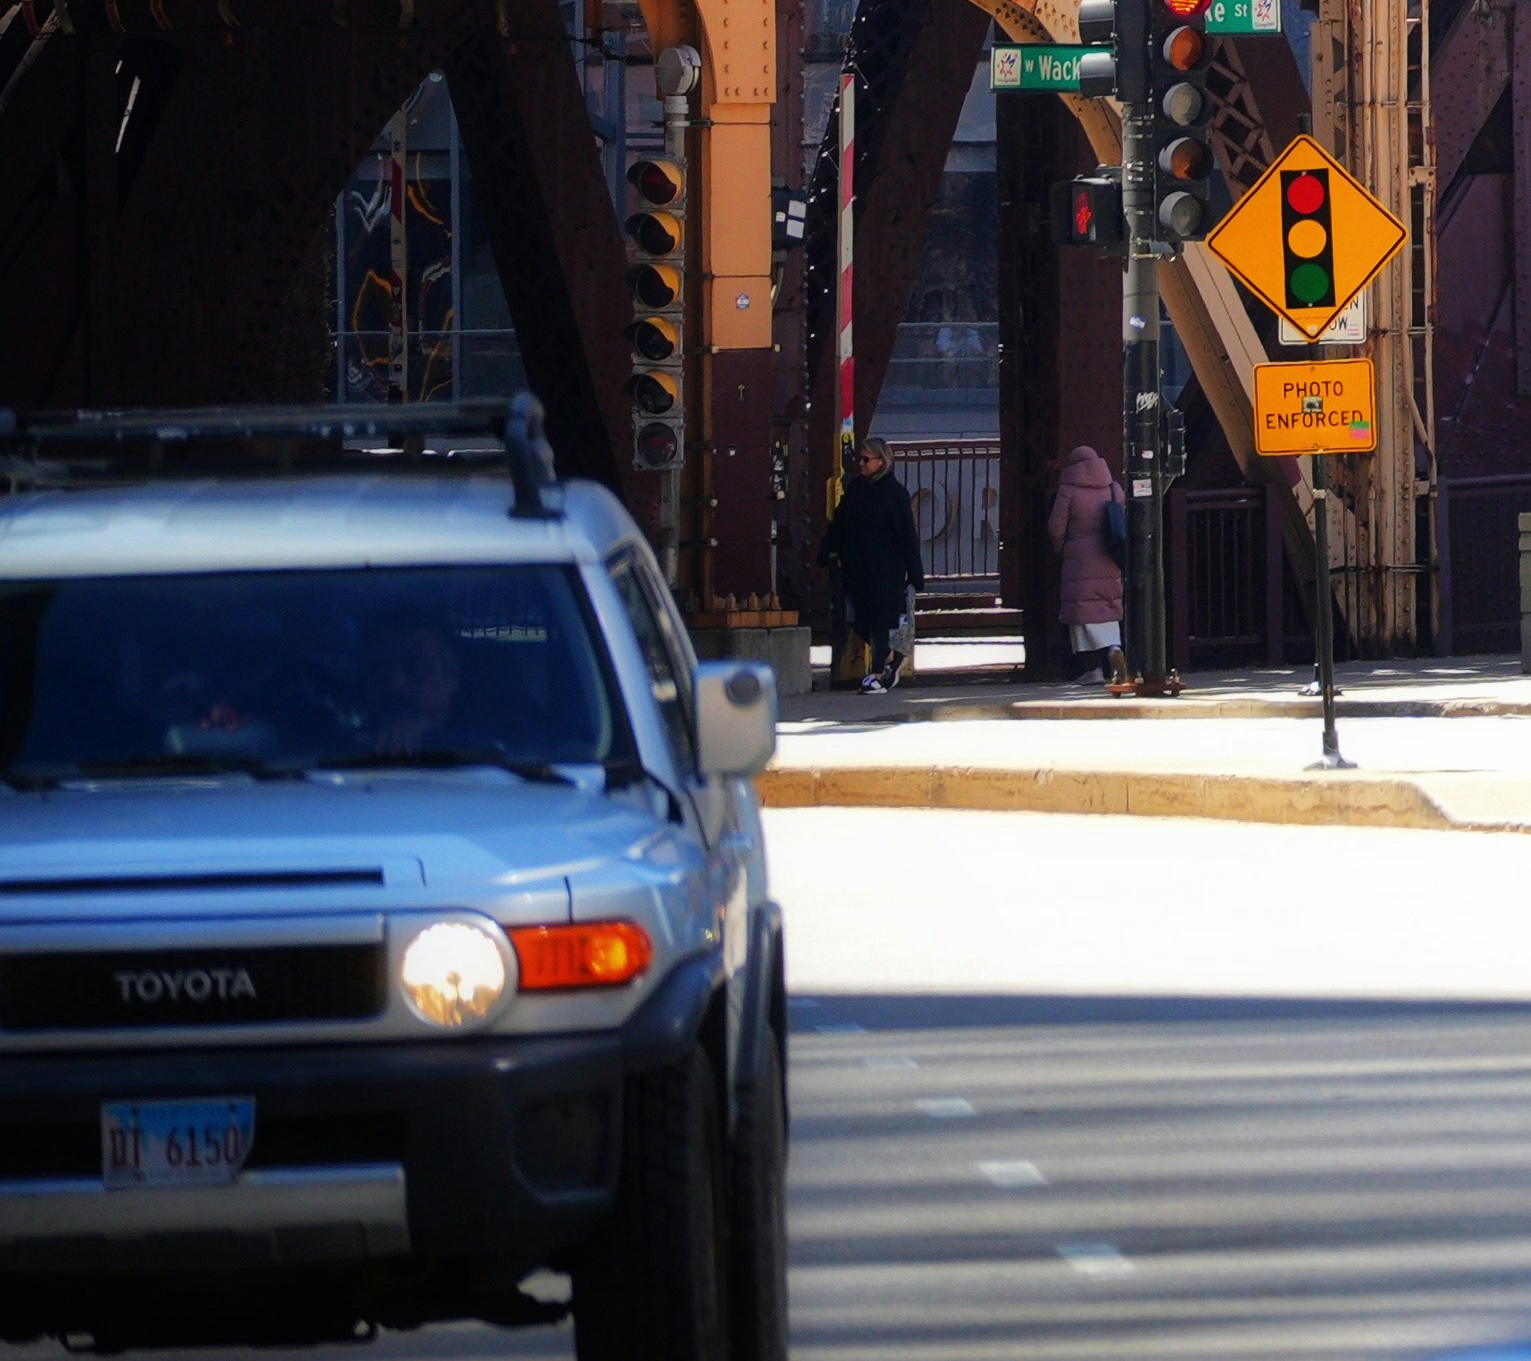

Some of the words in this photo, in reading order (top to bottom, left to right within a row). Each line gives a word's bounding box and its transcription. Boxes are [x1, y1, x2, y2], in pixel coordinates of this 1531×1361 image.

[1234, 3, 1248, 18] St
[1038, 54, 1082, 81] Wack
[1283, 380, 1344, 399] PHOTO
[1265, 410, 1364, 429] ENFORCED
[112, 967, 258, 1003] TOYOTA
